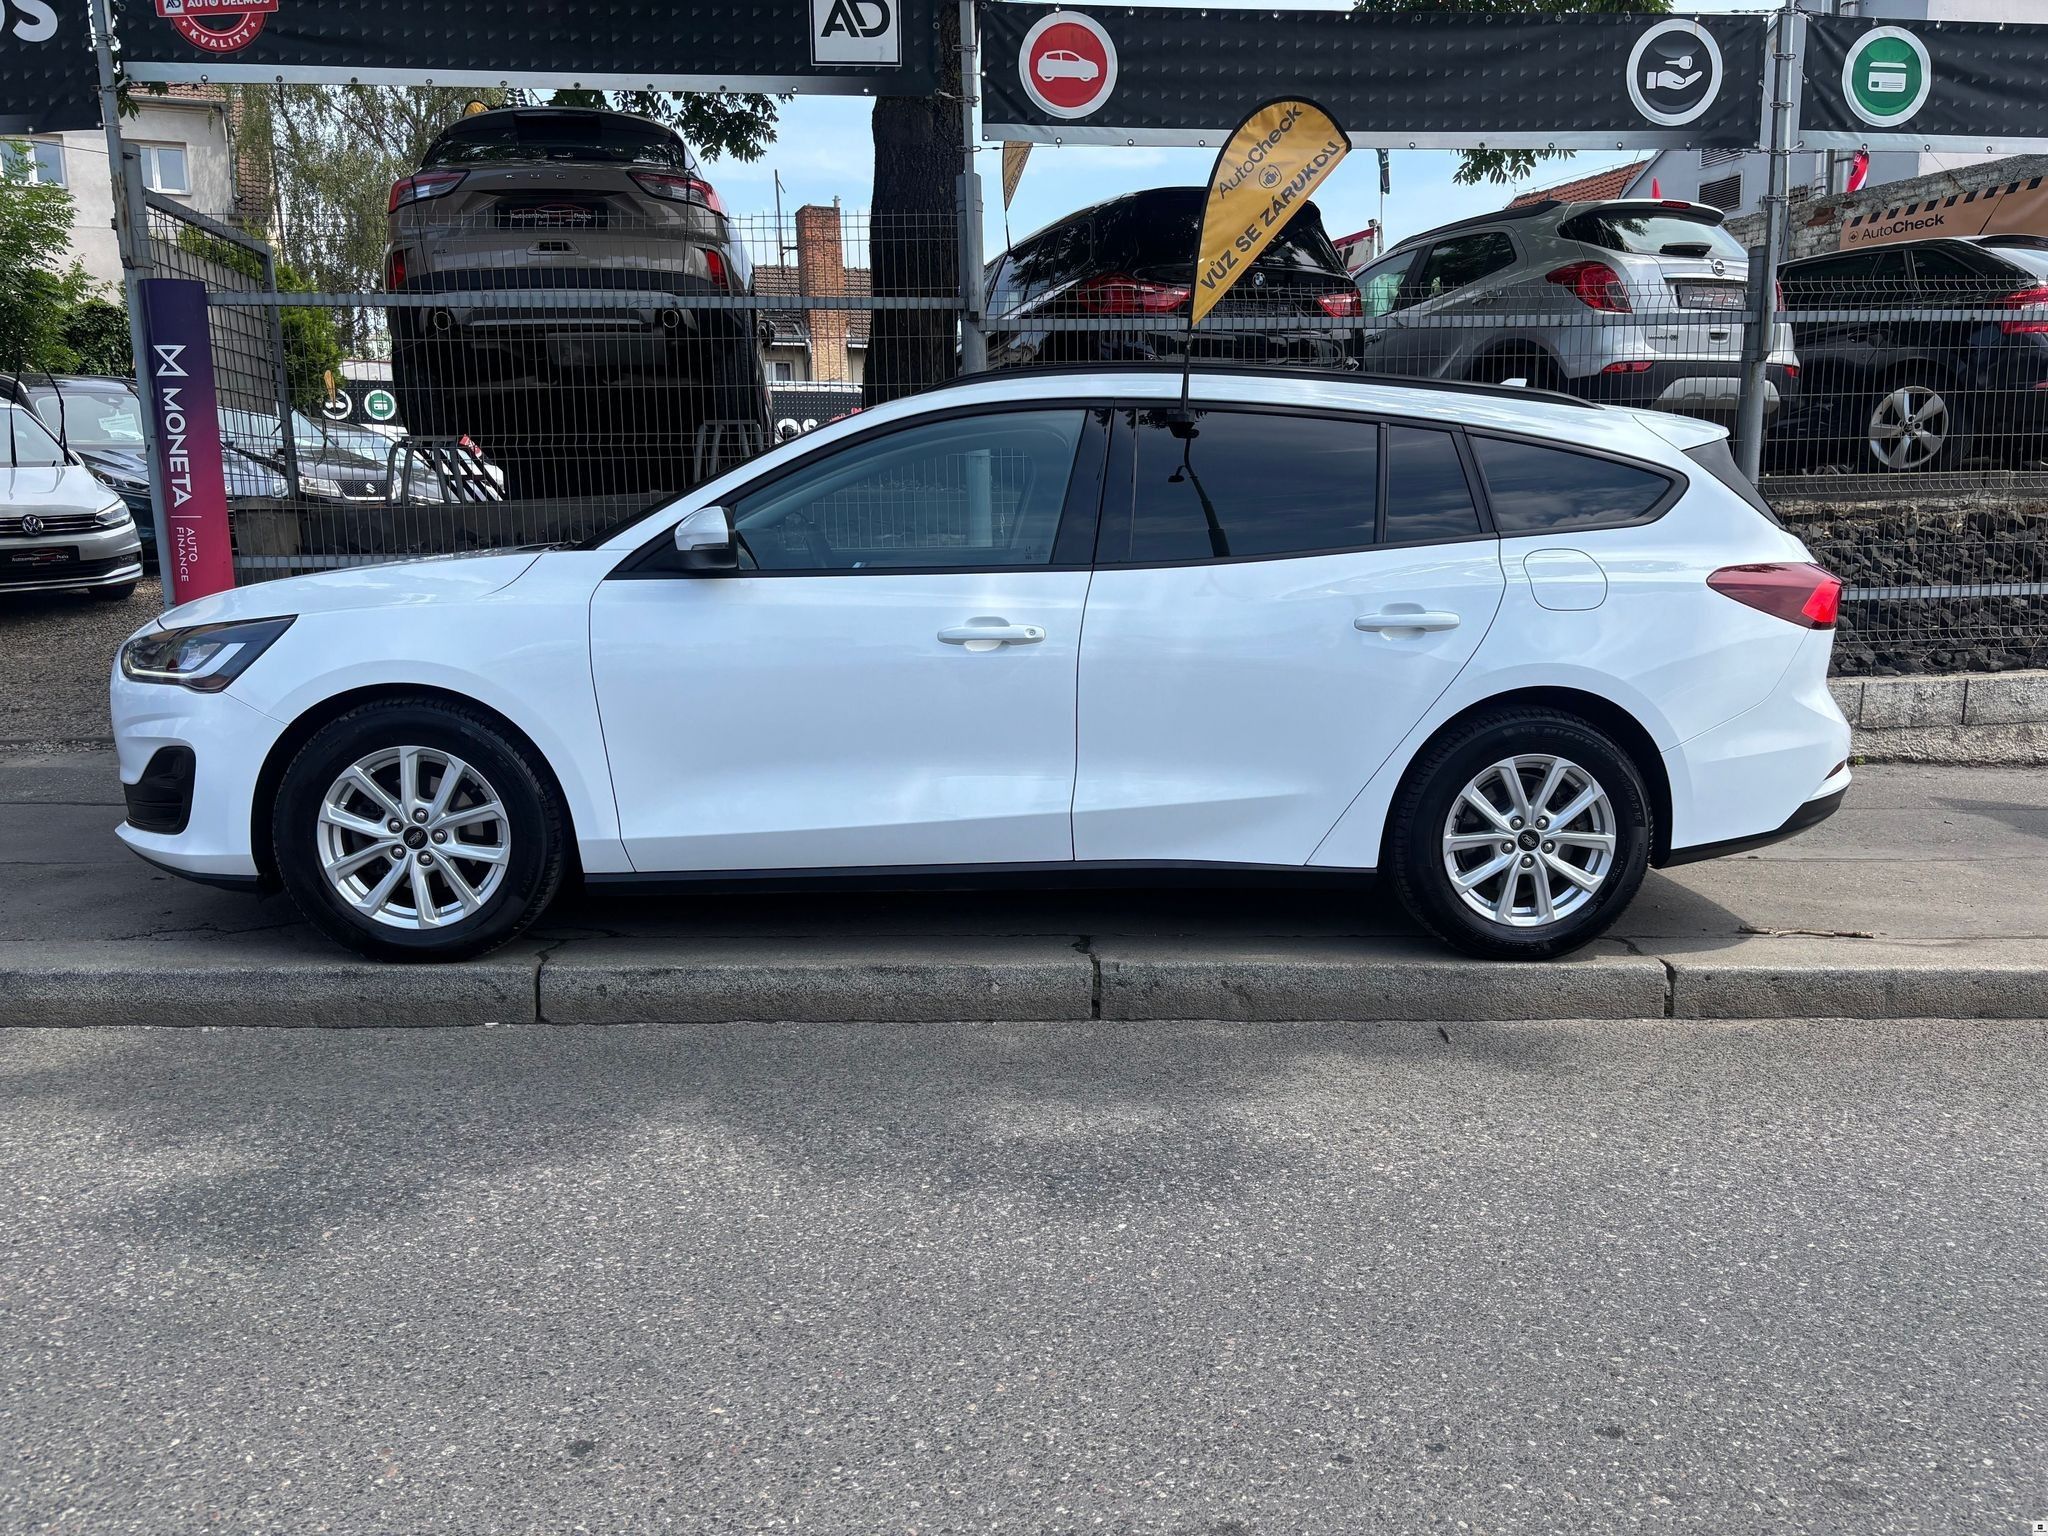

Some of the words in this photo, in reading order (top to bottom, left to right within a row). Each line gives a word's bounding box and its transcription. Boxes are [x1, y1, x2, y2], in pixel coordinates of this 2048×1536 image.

[189, 28, 251, 48] KVALITY
[1219, 104, 1304, 200] AutoCheck
[1200, 250, 1240, 290] VŮZ
[1235, 223, 1263, 253] SE
[1259, 140, 1341, 229] ZÁRUKOU
[1861, 213, 1945, 241] AutoCheck
[162, 387, 193, 509] MONETA
[176, 526, 190, 582] FINANCE
[185, 527, 198, 562] AUTO
